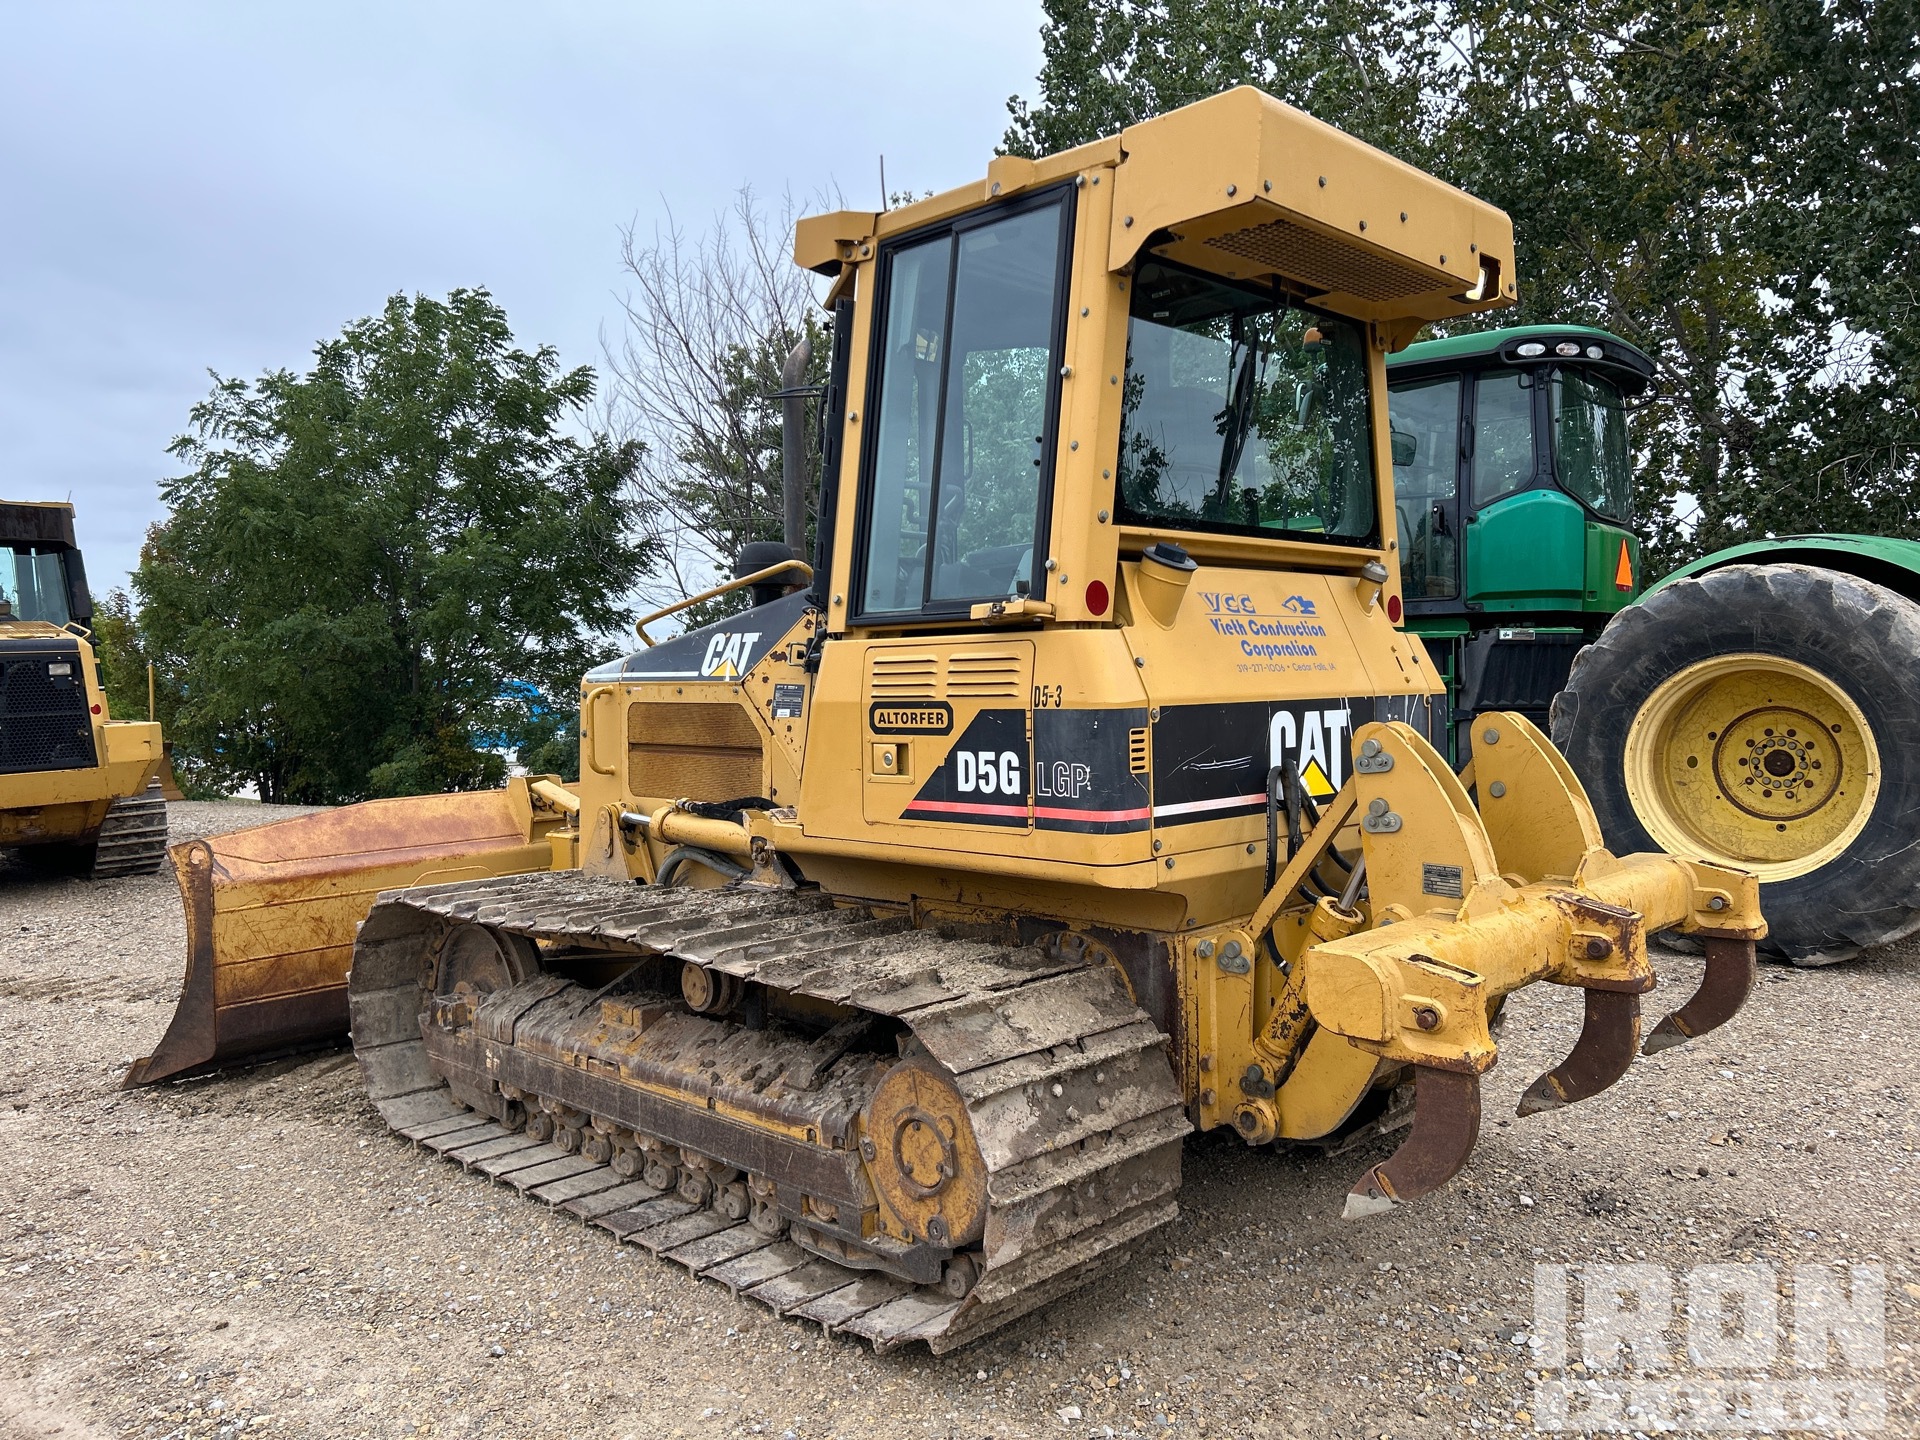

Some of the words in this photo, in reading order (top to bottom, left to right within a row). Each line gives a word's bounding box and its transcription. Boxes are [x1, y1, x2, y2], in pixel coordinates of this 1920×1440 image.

[1197, 592, 1256, 614] VCC
[1209, 617, 1248, 636] Vieth
[1247, 619, 1327, 637] Construction
[701, 632, 761, 677] CAT
[1240, 639, 1318, 660] Corporation
[1292, 662, 1312, 672] Cedar
[1033, 684, 1063, 708] D5-3
[877, 711, 945, 726] ALTORFER
[1269, 709, 1350, 801] CAT
[956, 750, 1021, 795] D5G
[1036, 760, 1090, 799] LGP
